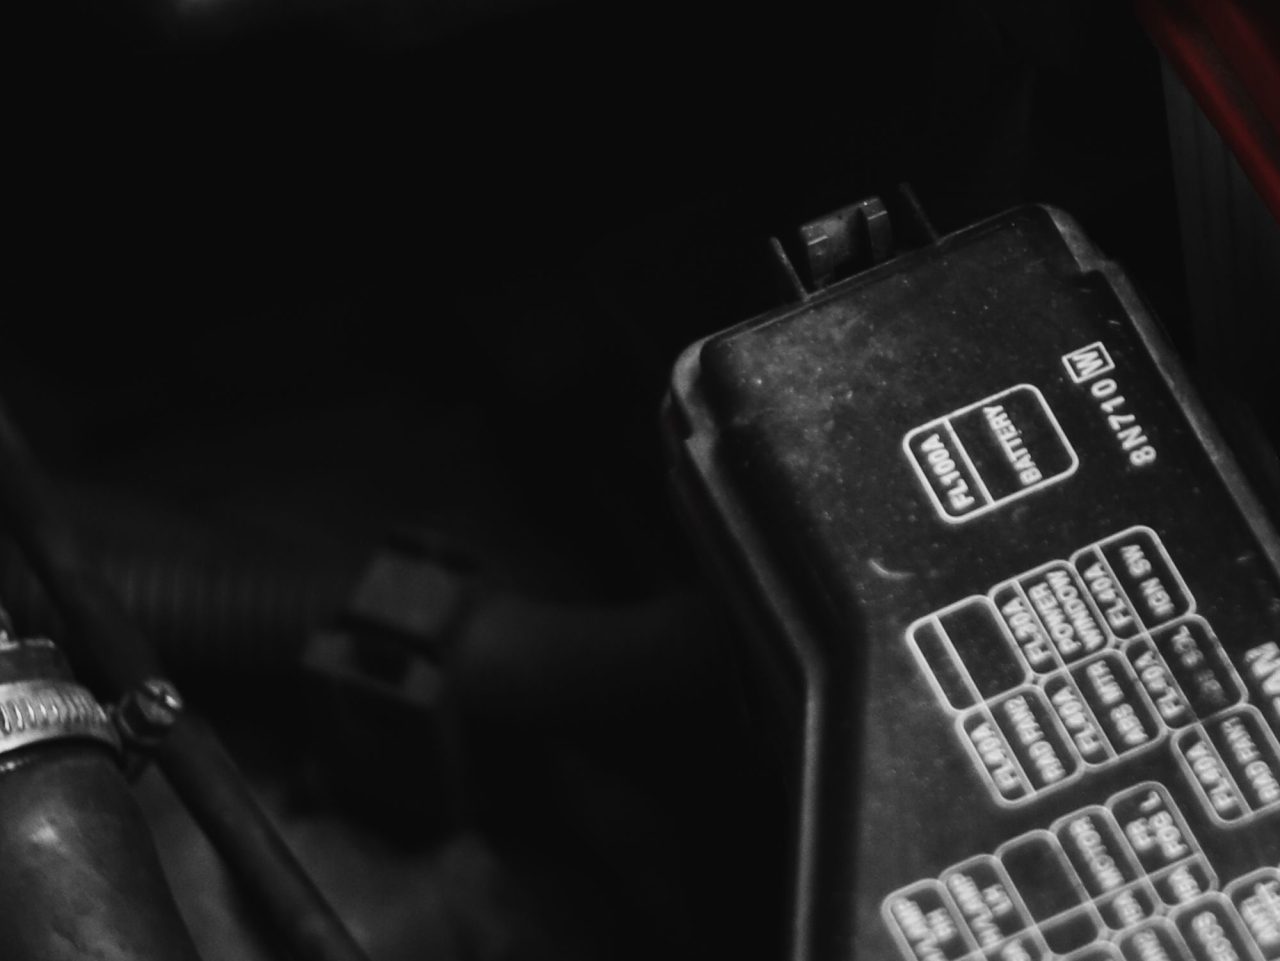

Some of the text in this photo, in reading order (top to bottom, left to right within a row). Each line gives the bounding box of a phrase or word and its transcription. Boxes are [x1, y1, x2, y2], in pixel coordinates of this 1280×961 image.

[982, 404, 1043, 486] BATTERY
[1071, 349, 1157, 467] 8N710 W
[920, 433, 975, 510] FL100A
[1028, 582, 1083, 656] POWER
[1046, 570, 1105, 652] WINDOW
[1084, 561, 1135, 630] FL40A
[1120, 544, 1175, 617] IGN SW
[1087, 660, 1150, 745] ABS MTR
[1070, 816, 1125, 890] MOTOR
